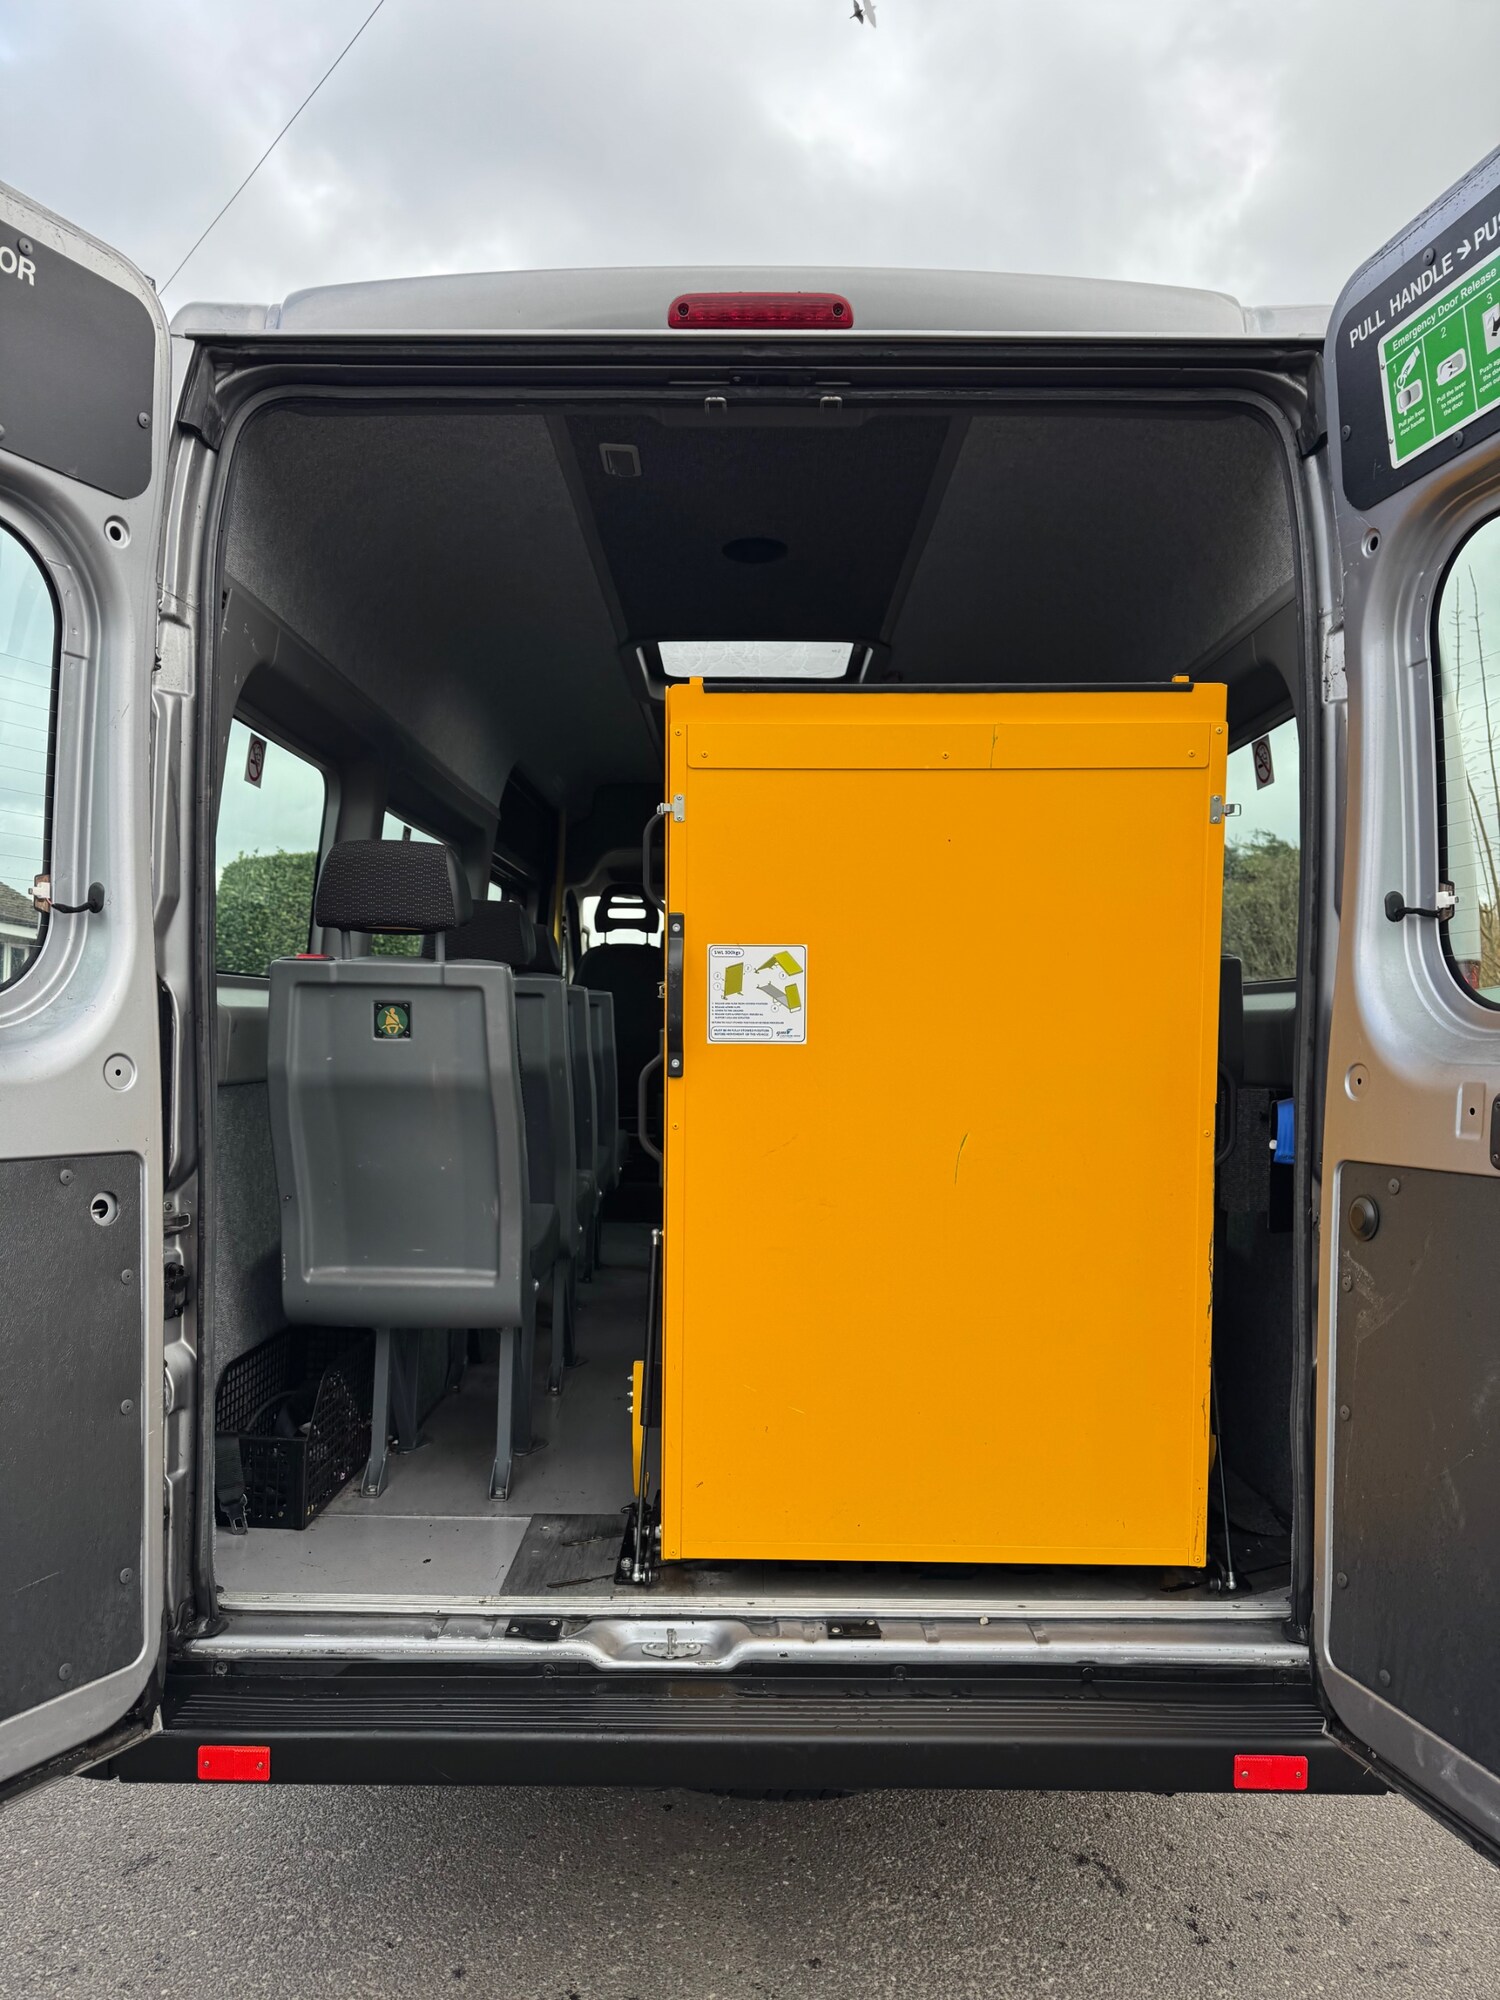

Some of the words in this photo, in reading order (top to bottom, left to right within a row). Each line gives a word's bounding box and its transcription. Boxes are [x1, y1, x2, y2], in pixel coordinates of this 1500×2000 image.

[1349, 309, 1386, 349] PULL
[1389, 252, 1454, 317] HANDLE
[1473, 211, 1500, 251] PU
[1486, 292, 1493, 304] 3
[1392, 312, 1437, 351] Emergency
[1437, 295, 1459, 317] Door
[1460, 267, 1497, 300] Release
[1440, 326, 1447, 339] 2
[1393, 363, 1397, 374] 1
[1479, 363, 1493, 376] Push
[1437, 393, 1446, 404] Pull
[1446, 389, 1454, 398] the
[1398, 419, 1407, 429] Pull
